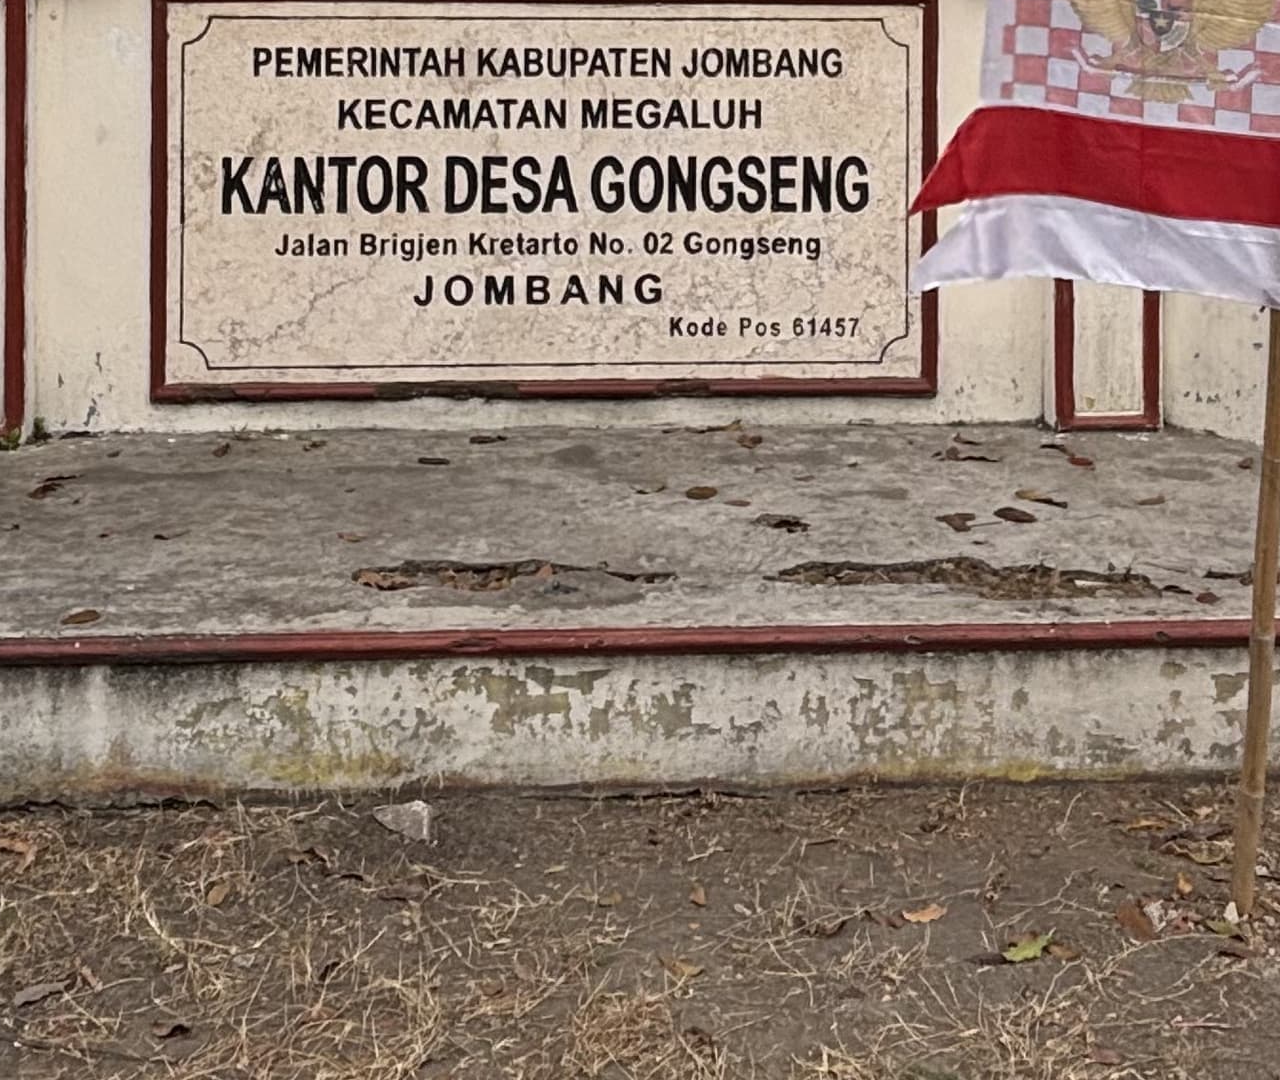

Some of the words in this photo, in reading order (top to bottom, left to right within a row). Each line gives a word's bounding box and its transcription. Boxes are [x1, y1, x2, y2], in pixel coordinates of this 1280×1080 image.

[253, 46, 465, 78] PEMERINTAH
[477, 47, 671, 78] KABUPATEN
[681, 47, 843, 79] JOMBANG
[337, 98, 567, 131] KECAMATAN
[581, 98, 762, 130] MEGALUH
[221, 154, 430, 215] KANTOR
[444, 155, 579, 214] DESA
[590, 155, 870, 214] GONGSENG
[274, 233, 349, 257] Jalan
[360, 232, 457, 262] Brigjen
[468, 232, 579, 256] Kretarto
[589, 231, 634, 255] No.
[643, 231, 674, 255] 02
[683, 231, 821, 261] Gongseng
[413, 273, 663, 307] JOMBANG
[669, 316, 728, 337] Kode
[739, 317, 781, 337] Pos
[792, 317, 860, 338] 61457
